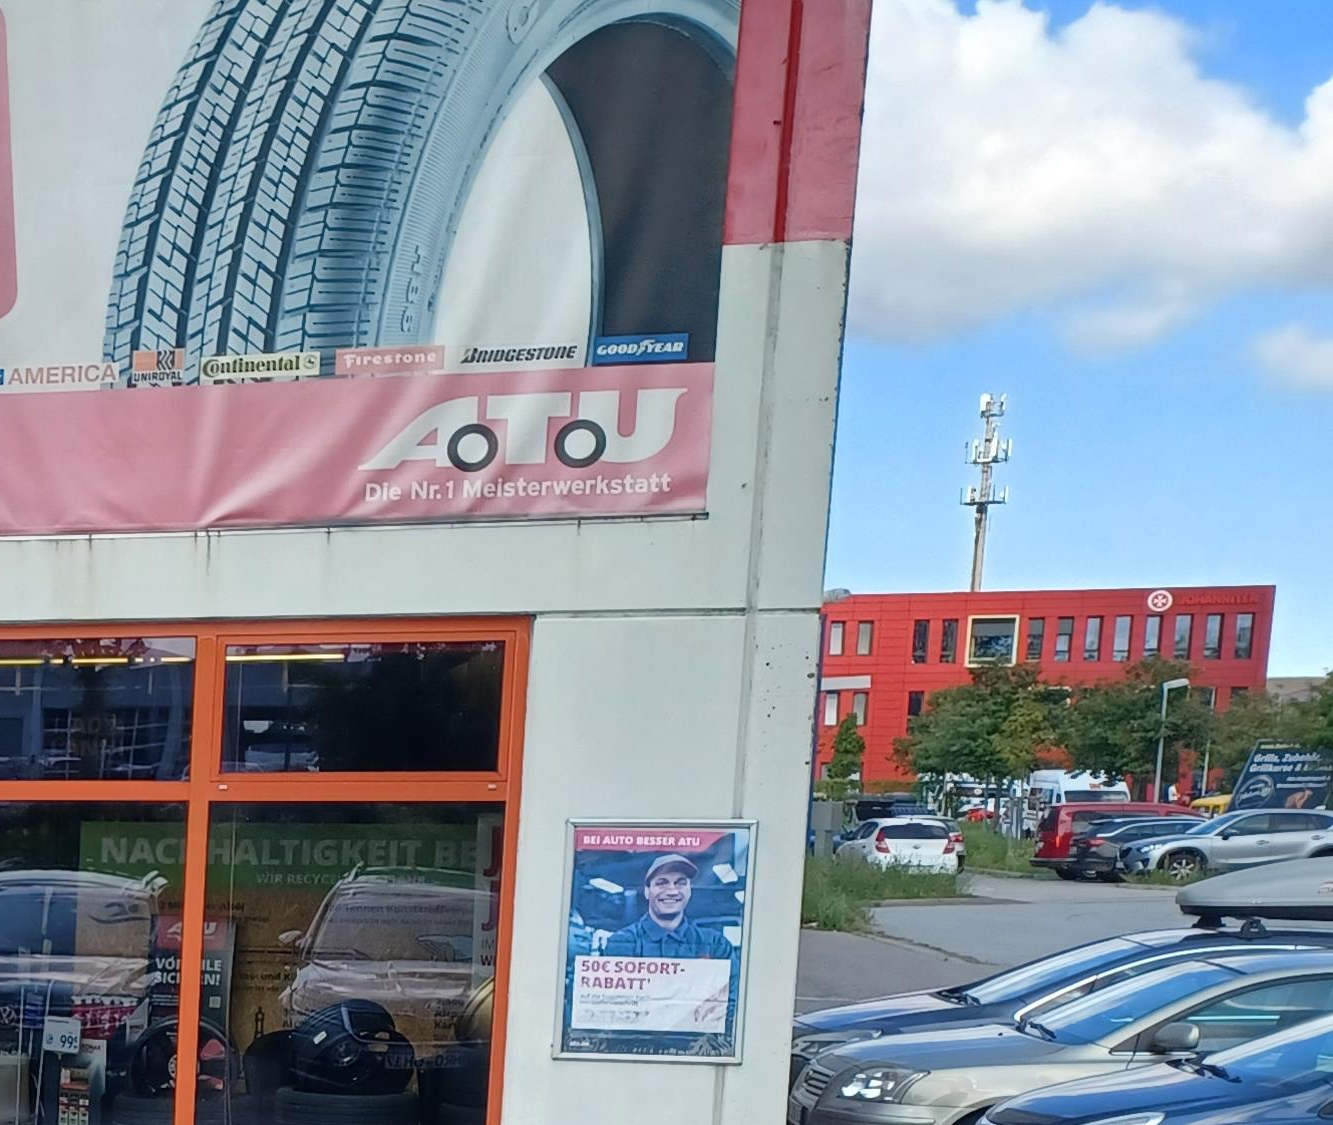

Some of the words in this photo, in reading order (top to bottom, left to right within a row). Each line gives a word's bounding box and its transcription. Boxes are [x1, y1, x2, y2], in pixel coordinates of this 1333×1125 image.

[344, 351, 437, 368] Firestone
[459, 345, 578, 364] BRIDGESTONE
[7, 363, 117, 386] AMERICA
[202, 354, 301, 379] Continental
[133, 371, 183, 383] UNIROYAL
[357, 387, 688, 472] ATU
[364, 482, 402, 502] Die
[462, 472, 673, 499] Meisterwerkstatt
[1178, 592, 1260, 607] JOHANNITER
[582, 835, 601, 845] BEI
[602, 835, 634, 846] AUTO
[635, 836, 676, 847] BESSER
[678, 836, 701, 847] ATU
[166, 921, 218, 943] AU
[154, 955, 223, 973] VOILE
[580, 959, 610, 974] 50€
[614, 961, 686, 975] SOFORT-
[153, 970, 222, 987] SICN!
